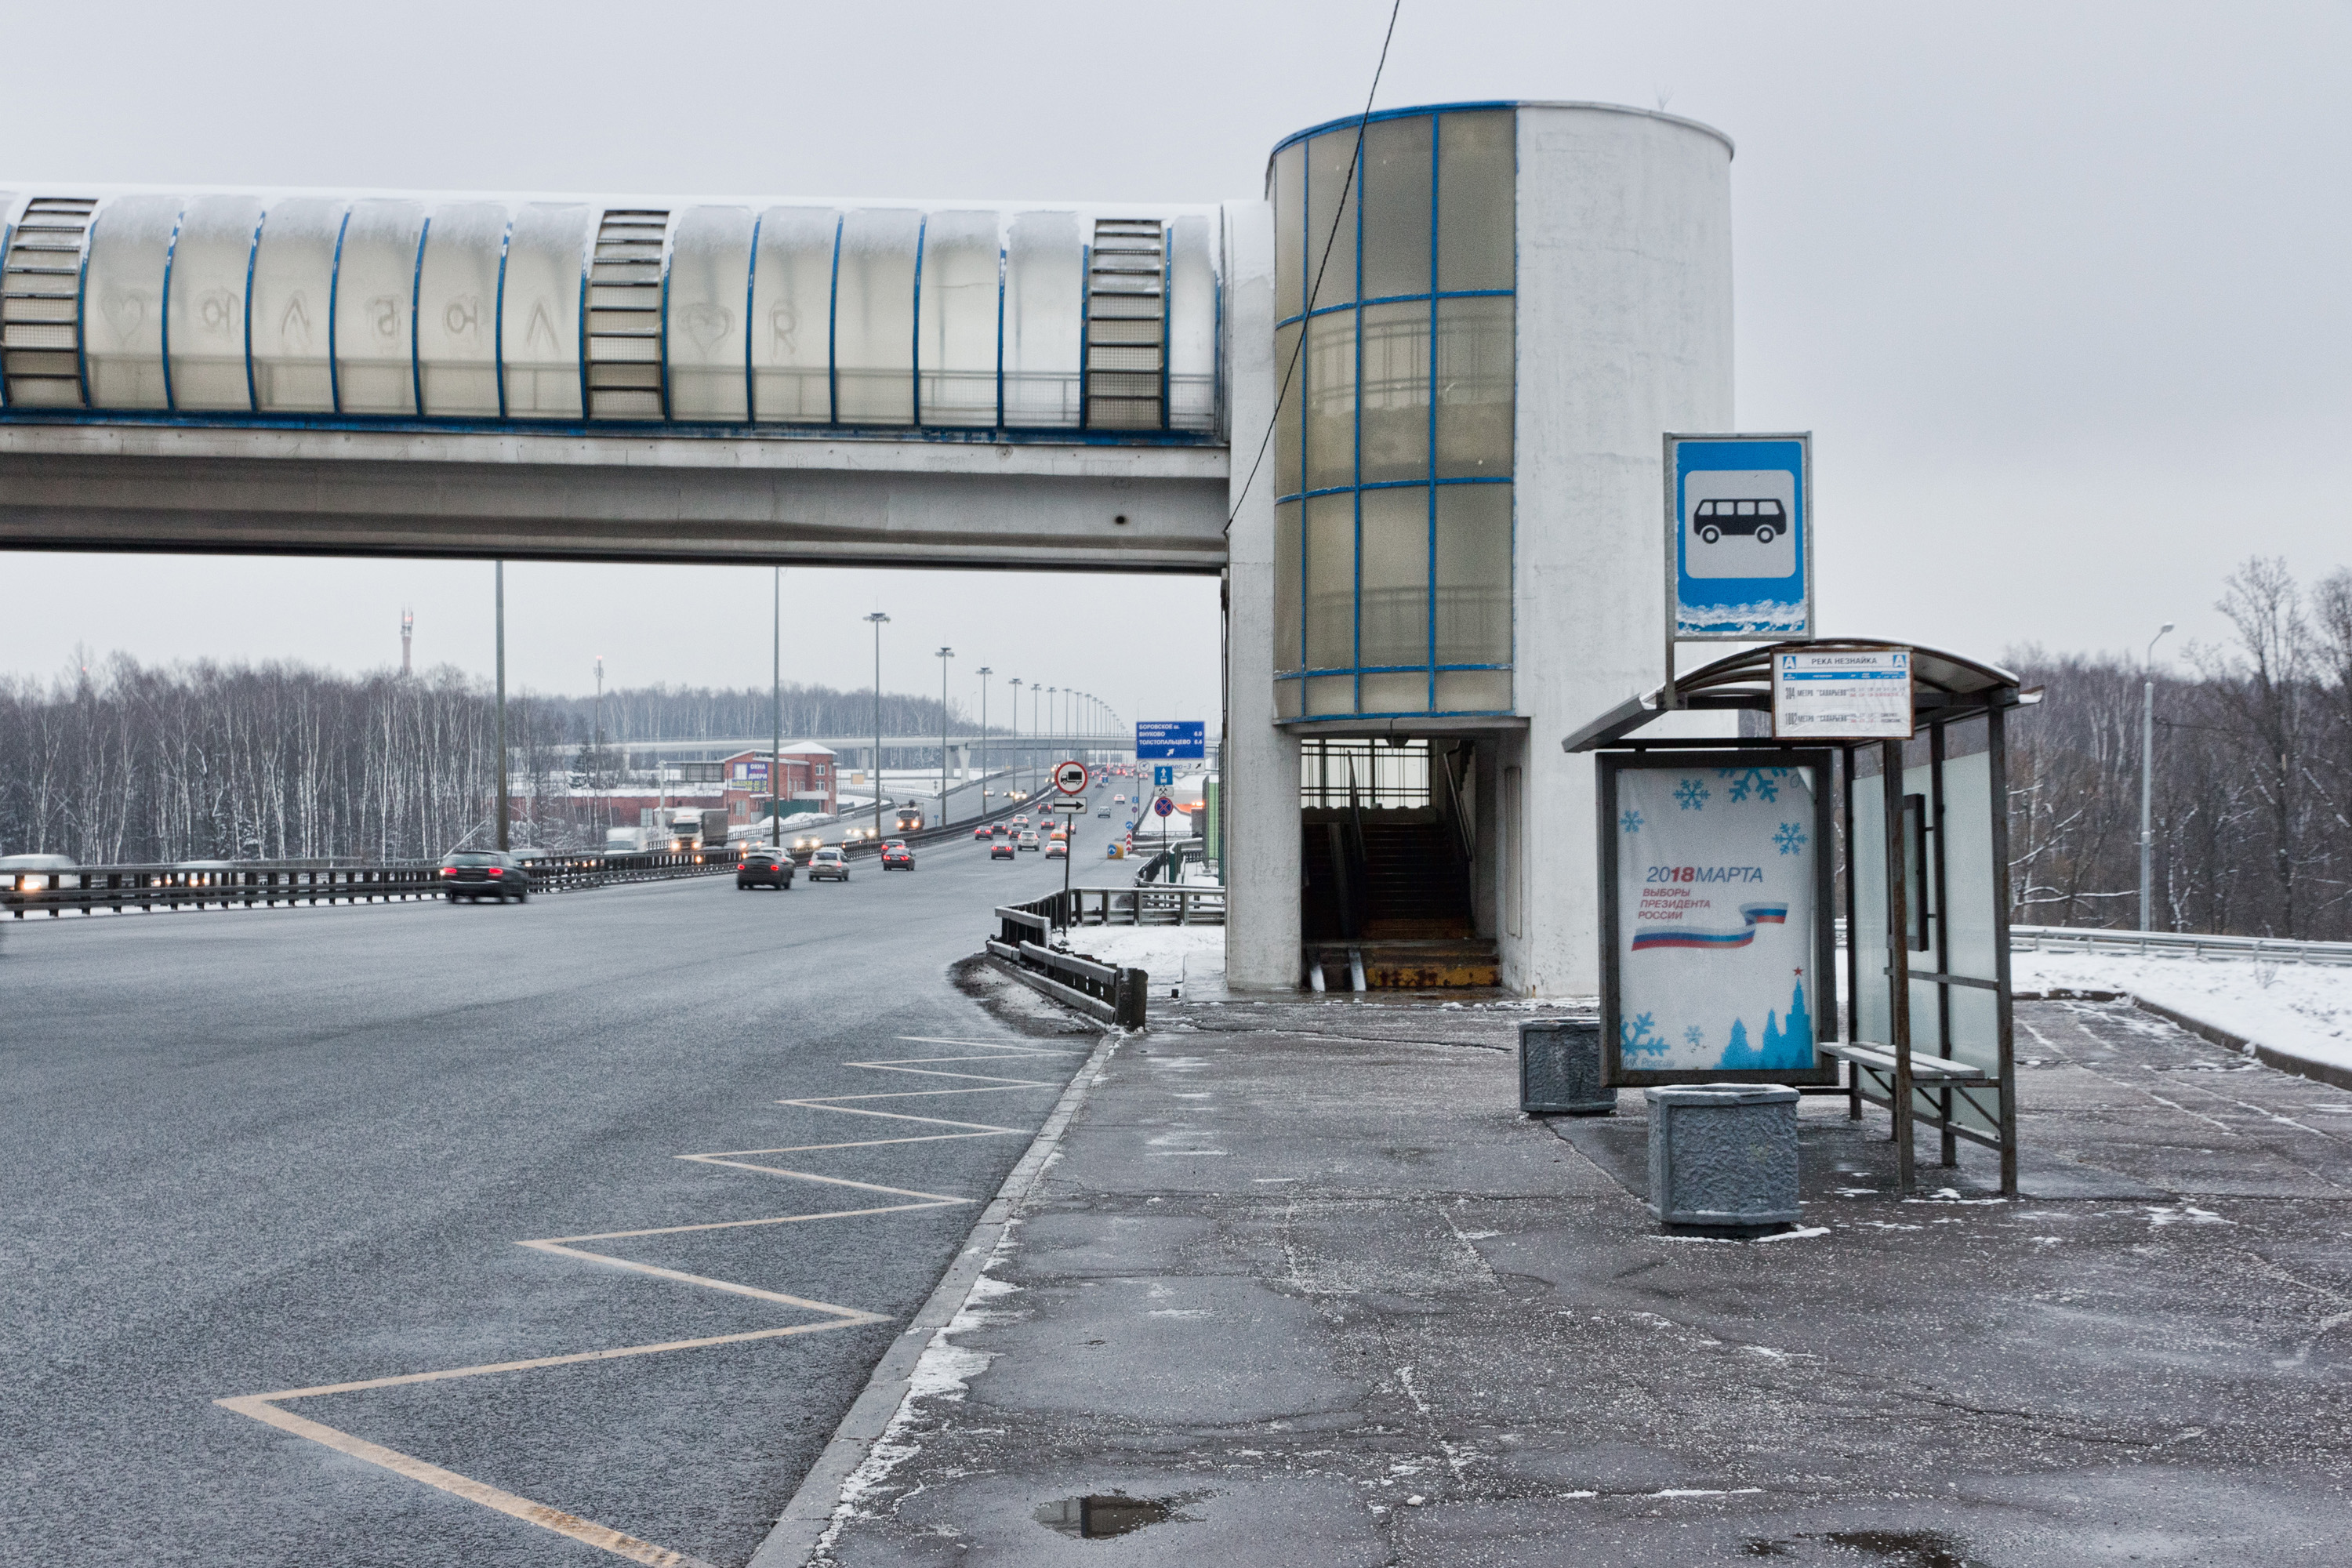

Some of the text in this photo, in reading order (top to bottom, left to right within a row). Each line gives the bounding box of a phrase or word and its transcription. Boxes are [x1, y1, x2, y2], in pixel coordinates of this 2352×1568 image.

[1642, 888, 1690, 897] ВЫБОРЫ
[1639, 899, 1711, 909] ПРЕЗИДЕНТА
[1638, 911, 1683, 920] РОССИИ
